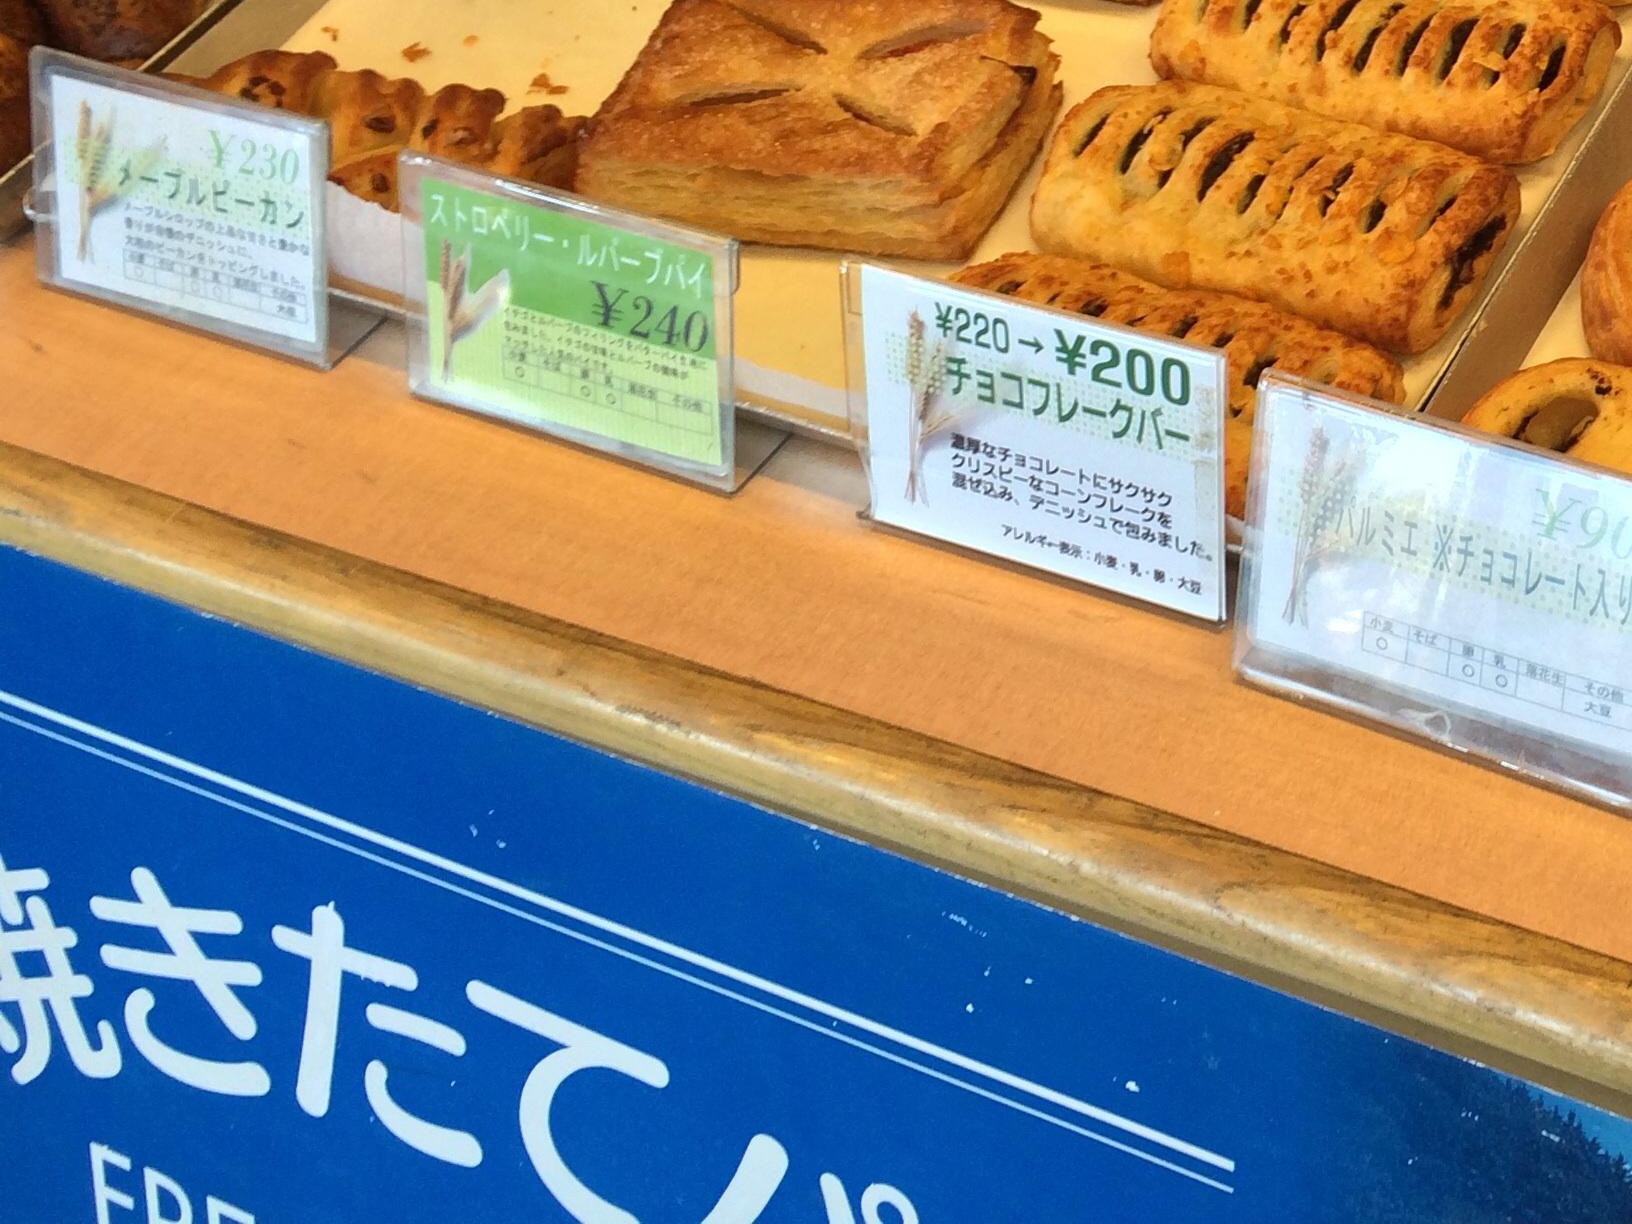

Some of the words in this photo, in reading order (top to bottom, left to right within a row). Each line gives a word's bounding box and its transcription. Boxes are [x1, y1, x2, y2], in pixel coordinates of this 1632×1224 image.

[119, 160, 304, 228] メープルピーカン
[208, 129, 300, 184] ¥230
[591, 280, 710, 353] ¥240
[935, 302, 1011, 355] ¥220
[1054, 328, 1191, 406] ¥200
[945, 356, 1191, 450] チョコフレークバー
[950, 431, 1173, 508] 濃厚なチョコレートにサクサク
[951, 452, 1173, 530] クリスピーなコーンフレークを
[951, 471, 1213, 562] 混ぜ込み、デニッシュで包みました。
[1334, 495, 1419, 557] パルミエ
